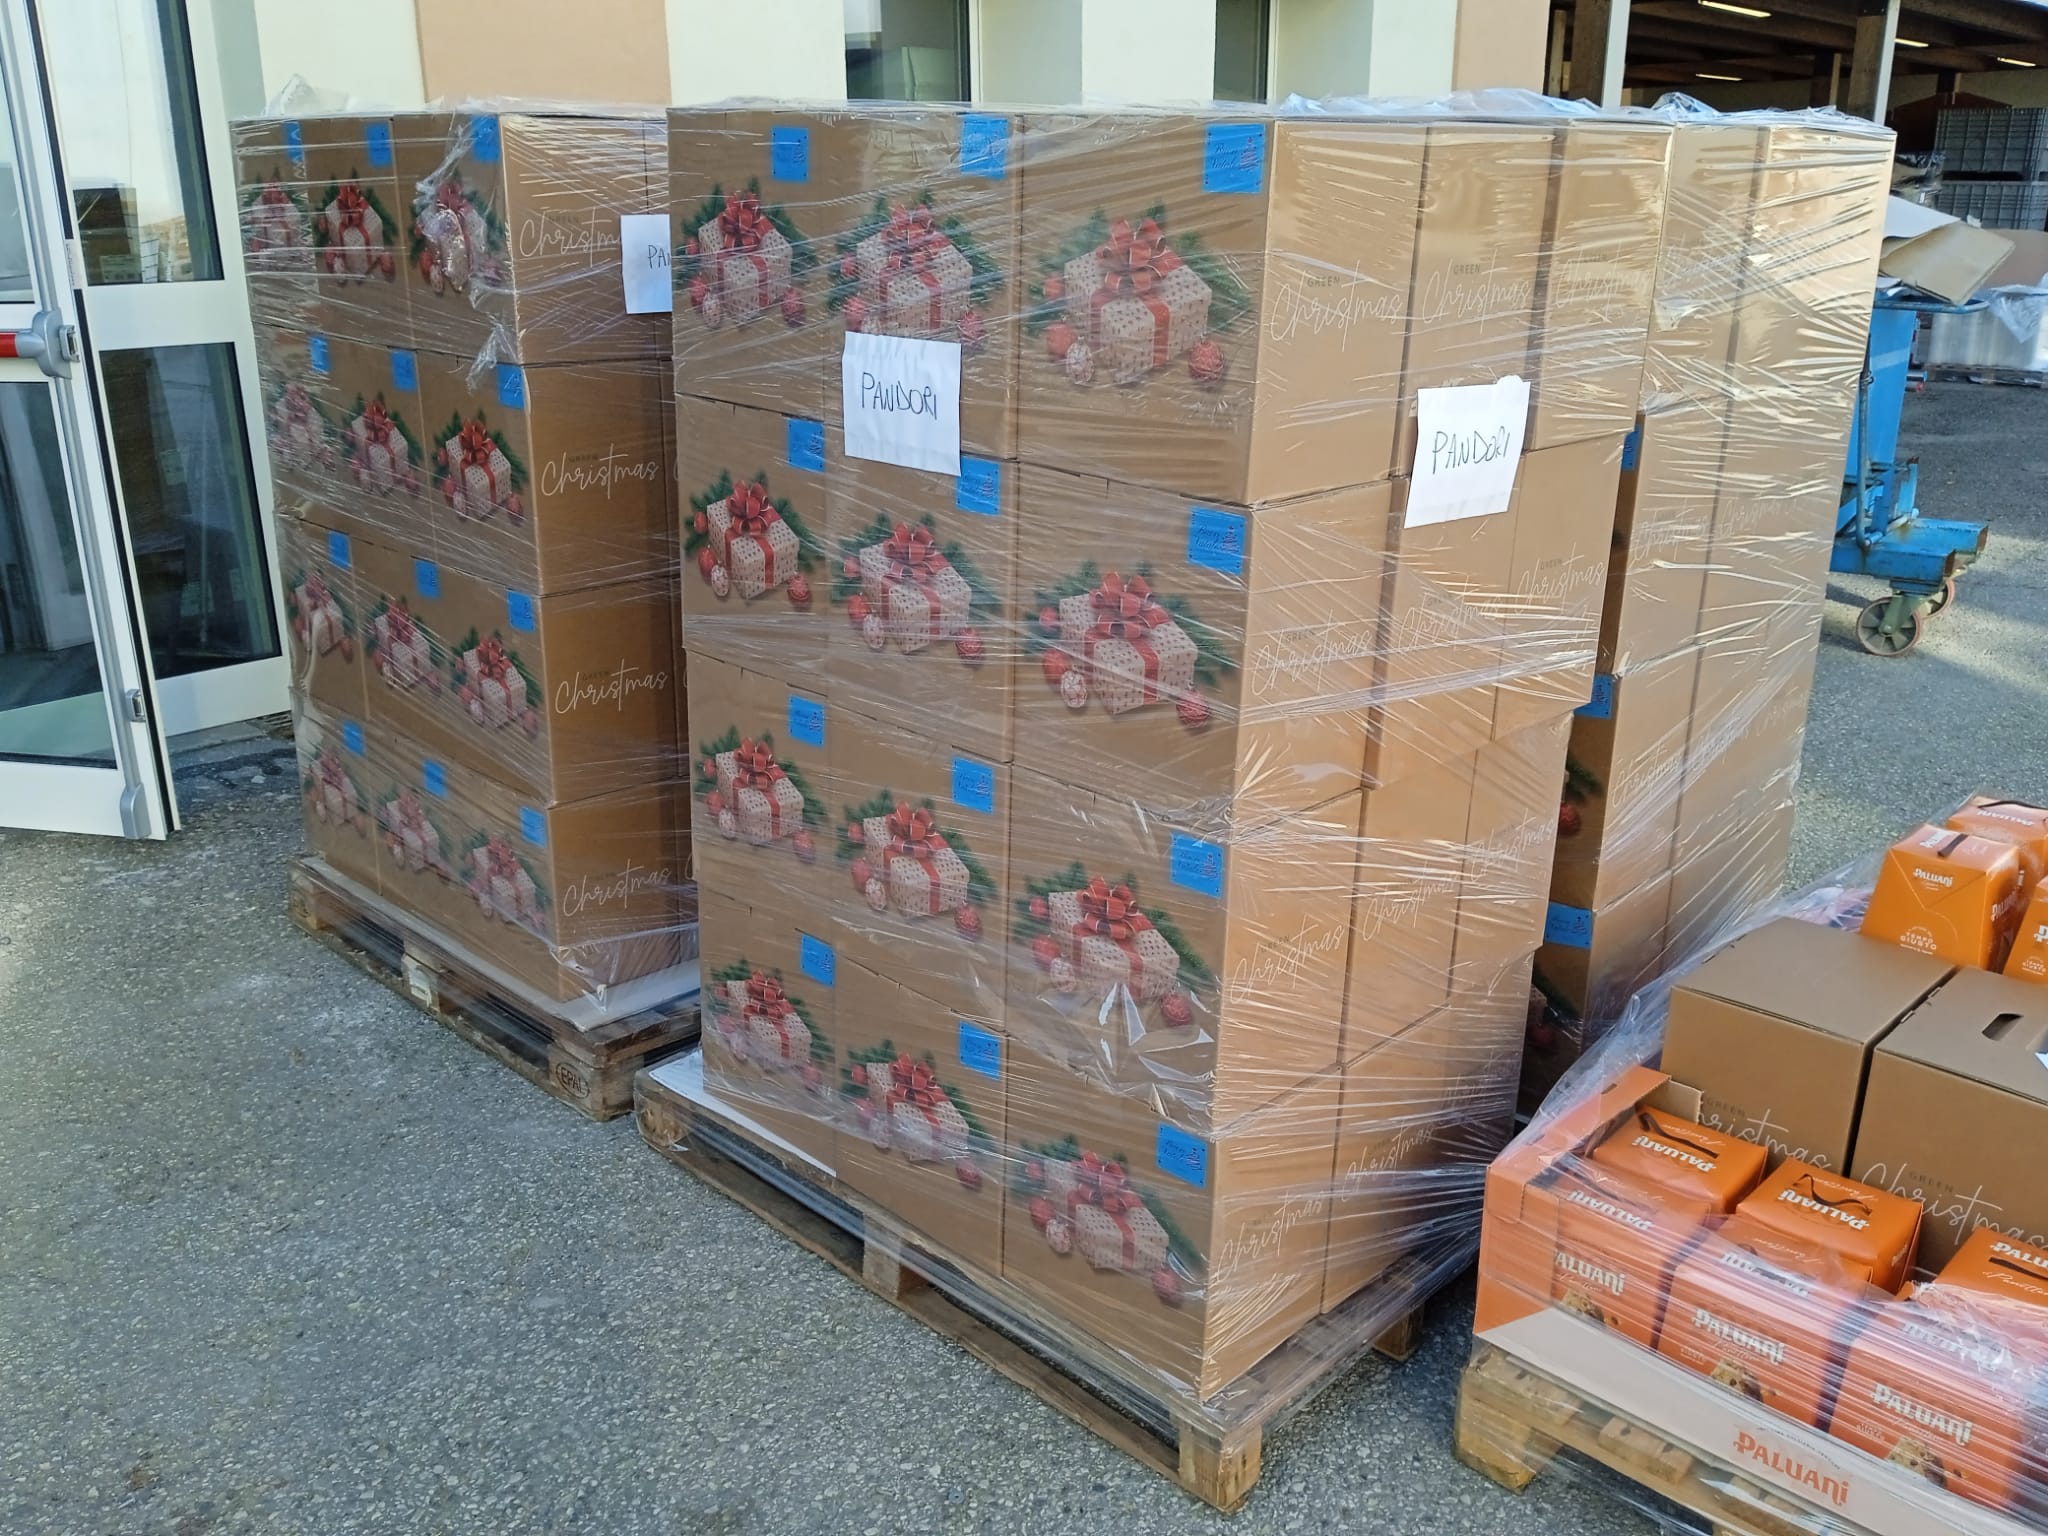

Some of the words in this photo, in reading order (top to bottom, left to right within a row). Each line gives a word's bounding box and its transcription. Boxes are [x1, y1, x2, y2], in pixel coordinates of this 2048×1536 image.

[1422, 248, 1532, 335] Christmas
[1453, 263, 1480, 275] GREEN
[1270, 259, 1403, 353] Christmas
[861, 371, 938, 421] PANDORI
[541, 442, 660, 500] Christmas
[1431, 425, 1511, 475] PANDORI
[554, 658, 668, 714] Christmas
[562, 858, 672, 917] Christmas
[1554, 1250, 1627, 1296] ALUANI
